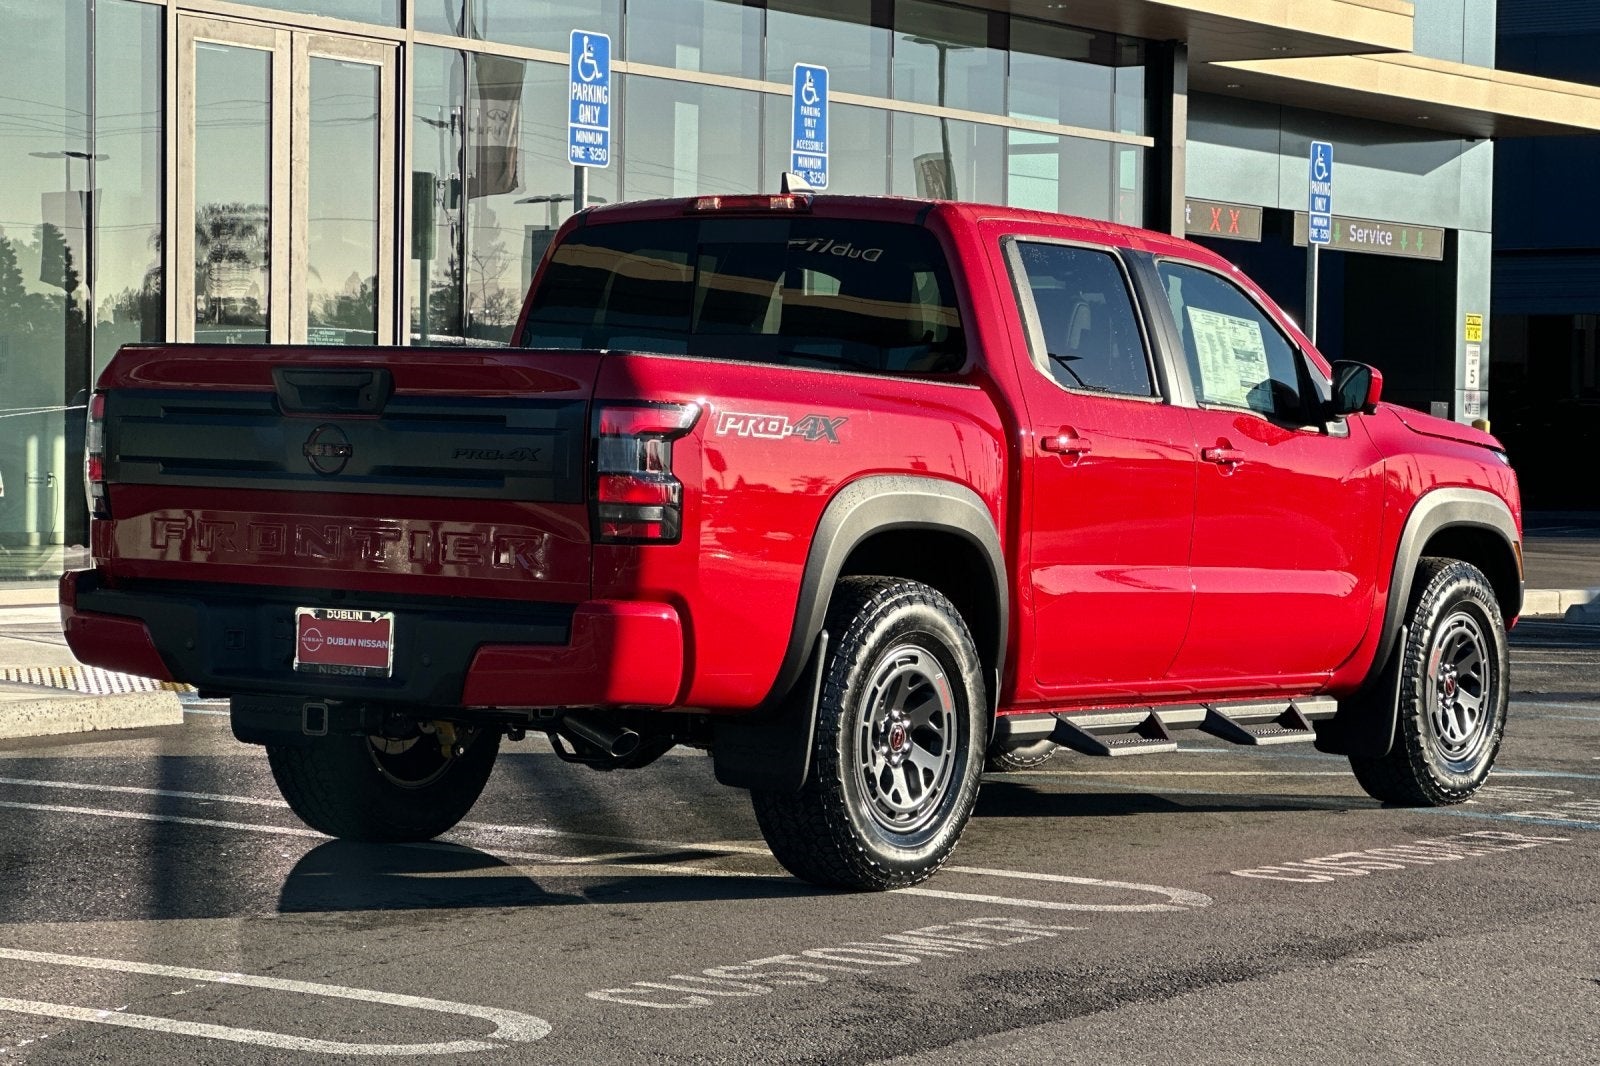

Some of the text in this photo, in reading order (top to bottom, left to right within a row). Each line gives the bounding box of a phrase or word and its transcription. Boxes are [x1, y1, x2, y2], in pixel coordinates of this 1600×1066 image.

[572, 82, 608, 104] PARKING
[579, 104, 600, 124] ONLY
[800, 106, 821, 117] PARKING
[804, 118, 817, 129] ONLY
[576, 130, 603, 145] MINIMUM
[571, 145, 607, 161] FINE $250
[796, 140, 824, 152] ACCESSIBLE
[798, 156, 822, 169] MINIMUM
[810, 172, 826, 184] $250
[1311, 181, 1331, 196] PARKING
[1315, 197, 1326, 211] ONLY
[1350, 224, 1393, 246] Service
[1470, 369, 1476, 384] 5
[151, 516, 548, 573] FRONTIER
[326, 610, 363, 620] DUBLIN
[326, 637, 388, 649] DUBLIN NISSAN
[319, 665, 367, 676] NISSAN
[584, 917, 1090, 1009] CUSTOMER
